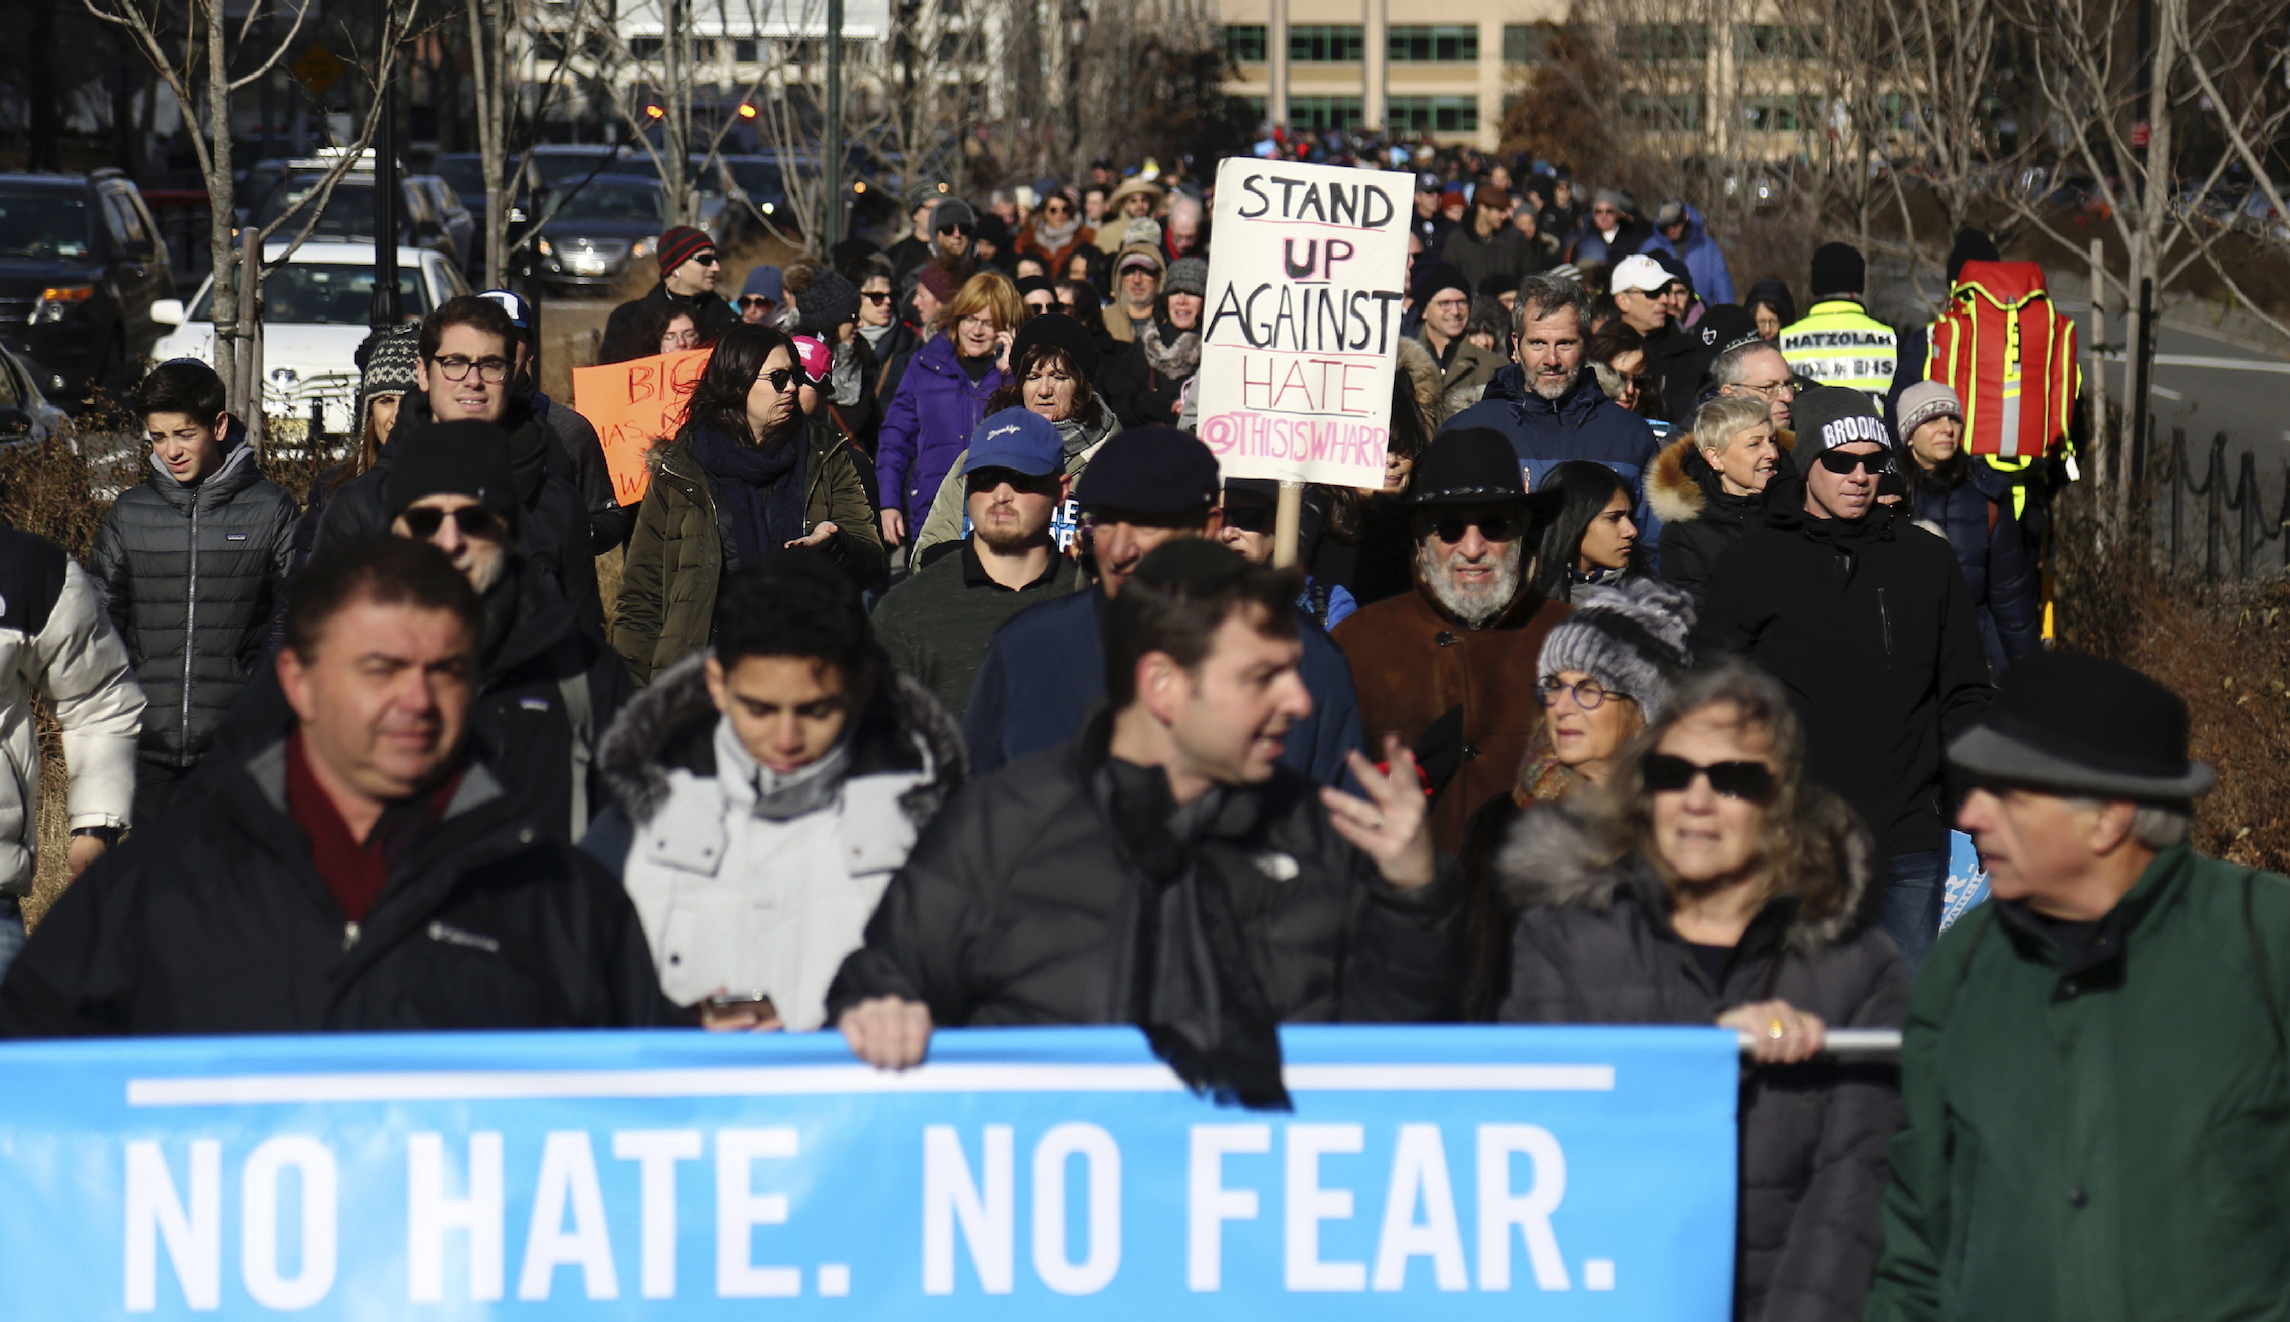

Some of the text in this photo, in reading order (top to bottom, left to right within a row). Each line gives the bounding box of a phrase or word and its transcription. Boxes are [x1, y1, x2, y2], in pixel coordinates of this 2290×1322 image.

[1238, 174, 1395, 228] STAND
[1283, 237, 1354, 280] UP
[1204, 280, 1404, 354] AGAINST
[1785, 332, 1891, 348] HATZOLAH
[1200, 411, 1388, 468] @THISISWHARR
[124, 1121, 1616, 1313] NO HATE. NO FEAR.
